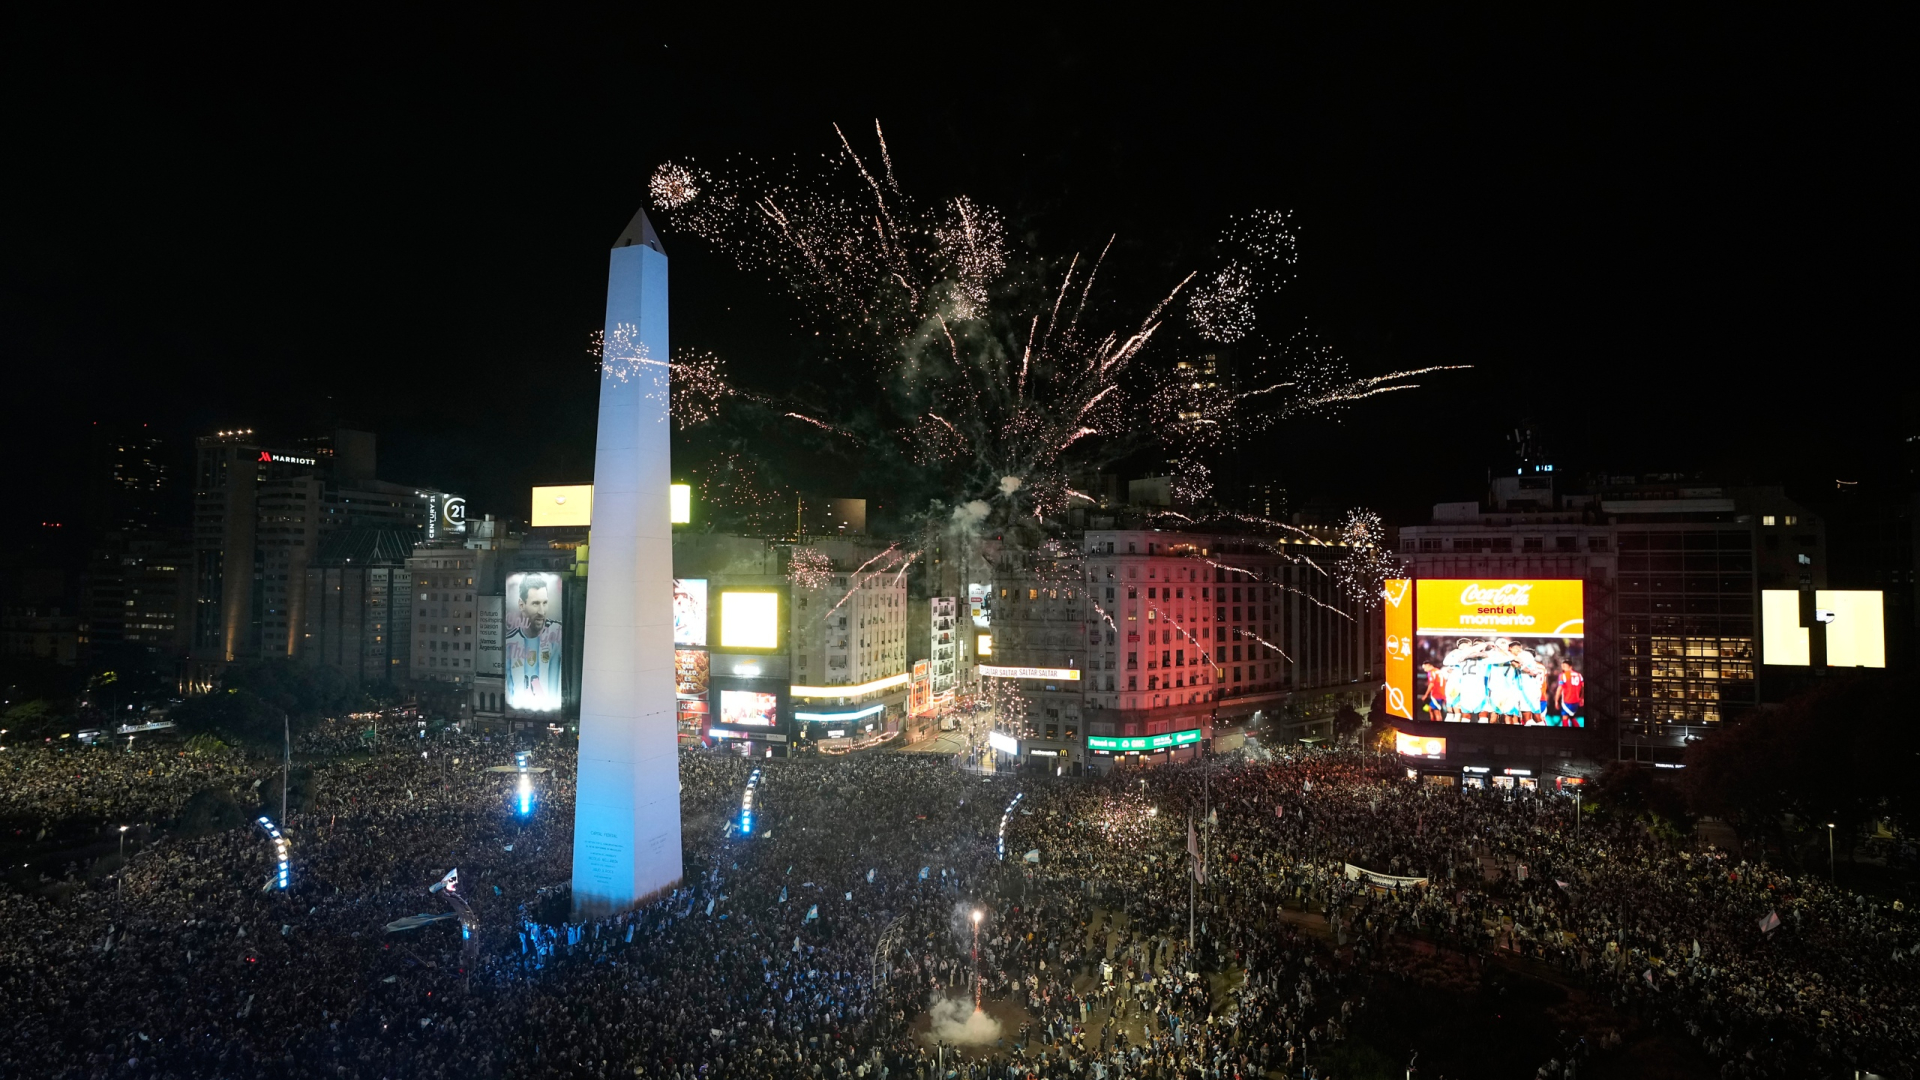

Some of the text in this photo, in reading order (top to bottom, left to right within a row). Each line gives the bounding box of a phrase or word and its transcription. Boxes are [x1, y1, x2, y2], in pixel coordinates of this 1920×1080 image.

[272, 454, 316, 465] MARRIOTT
[430, 495, 436, 503] 21
[1460, 584, 1533, 606] Coca-Cola
[1477, 605, 1517, 614] sentí el
[1460, 614, 1536, 626] momento
[999, 668, 1018, 677] SALTAR
[1019, 668, 1038, 677] SALTAR
[1039, 669, 1058, 677] SALTAR
[679, 682, 698, 690] KFC
[681, 703, 696, 711] KFC
